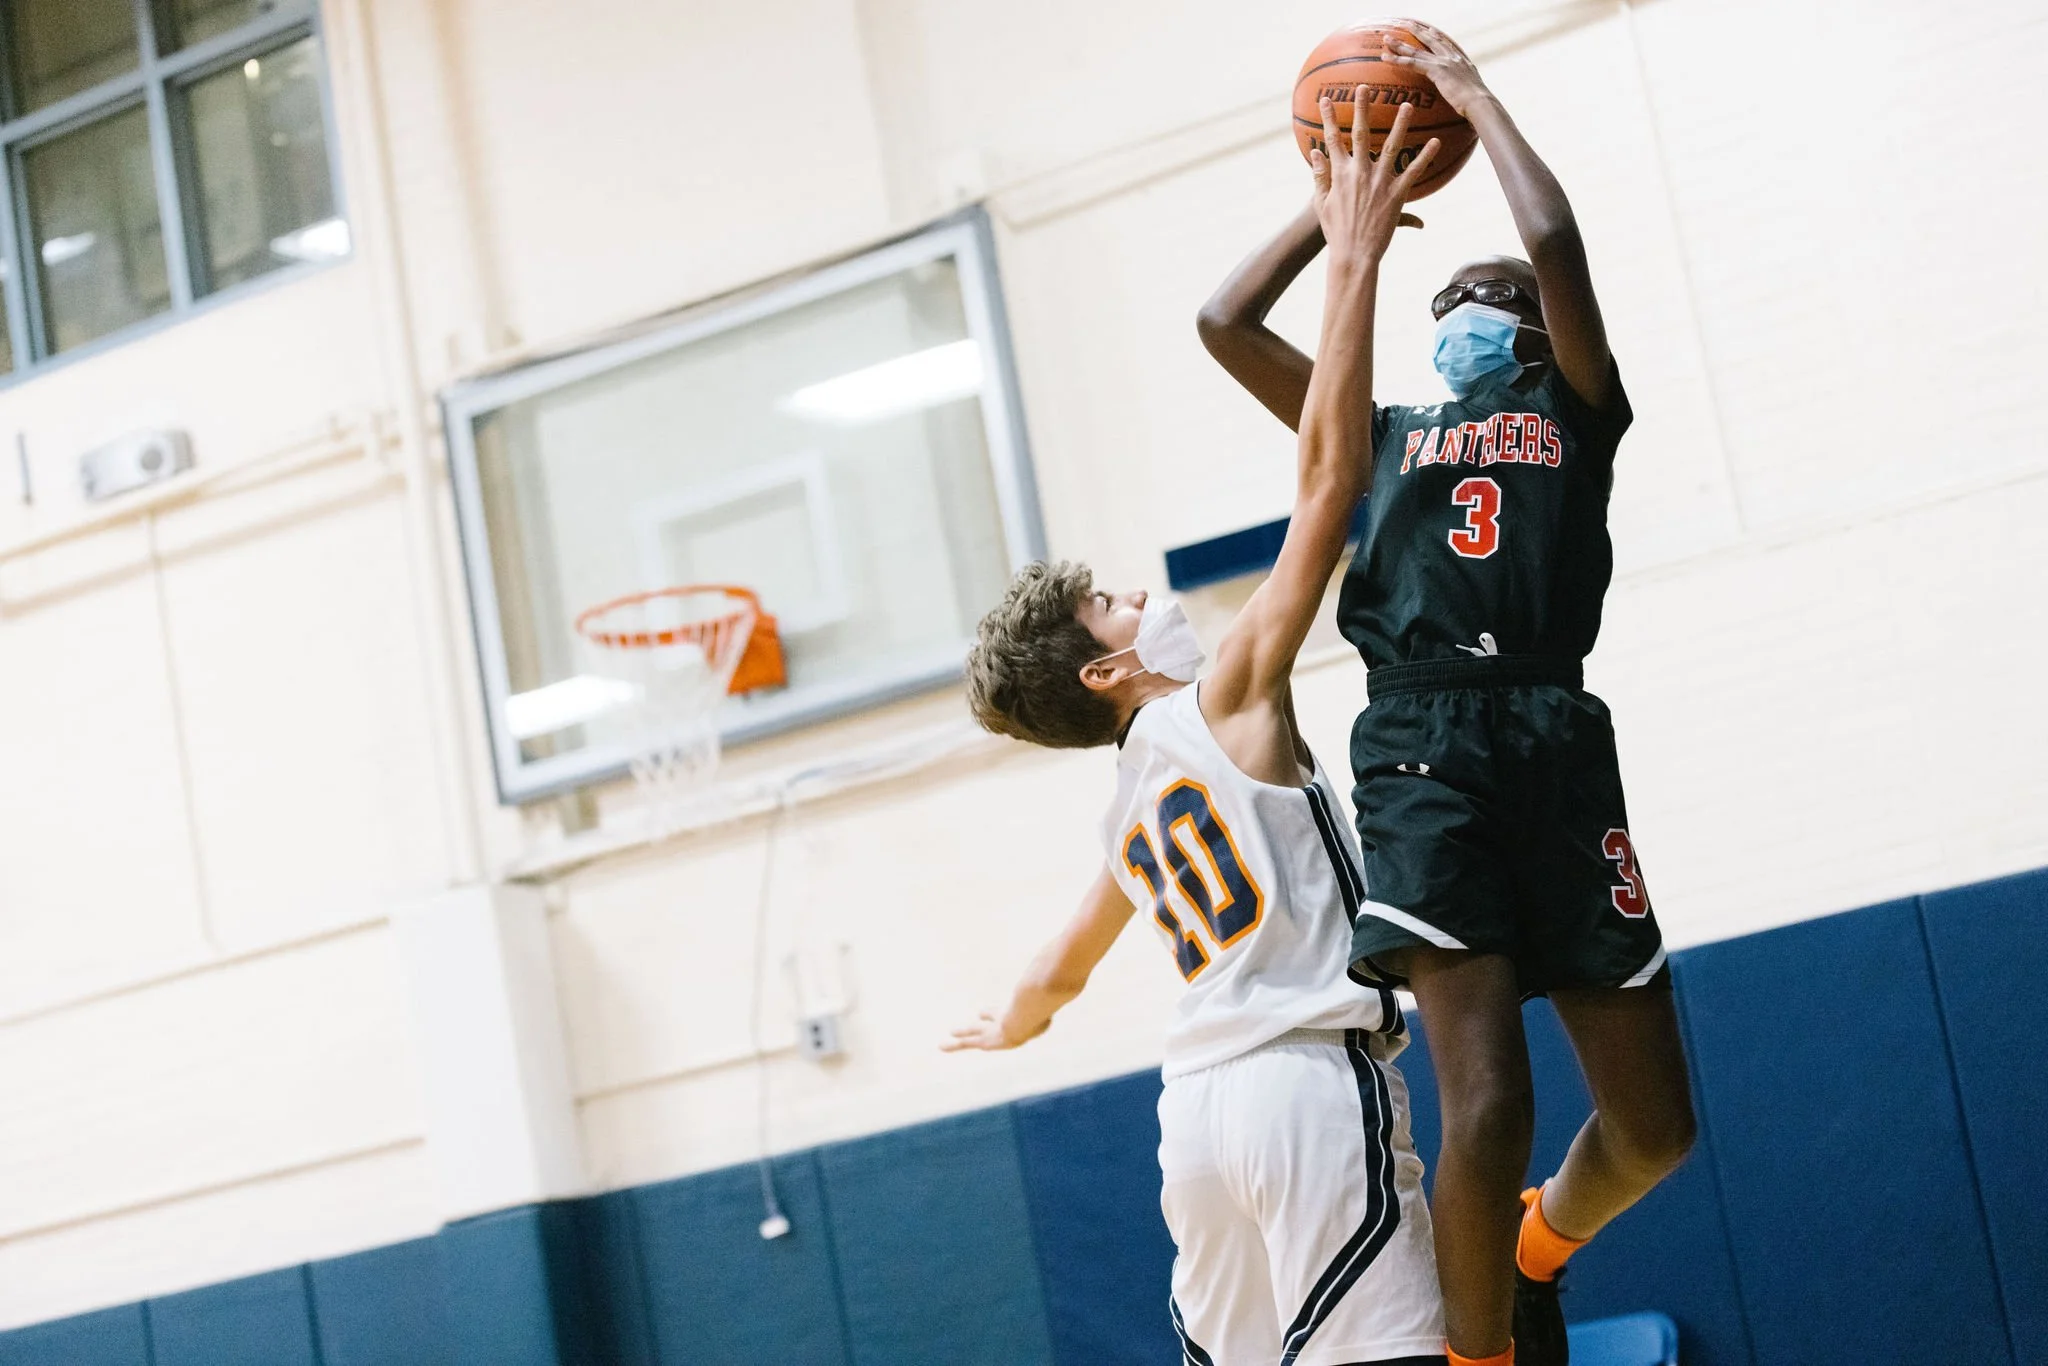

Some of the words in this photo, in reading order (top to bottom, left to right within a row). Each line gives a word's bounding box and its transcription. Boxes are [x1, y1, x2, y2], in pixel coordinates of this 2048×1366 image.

[1400, 411, 1562, 475] PANTHERS
[1447, 477, 1502, 560] 3
[1122, 777, 1265, 984] 10
[1601, 827, 1649, 919] 3
